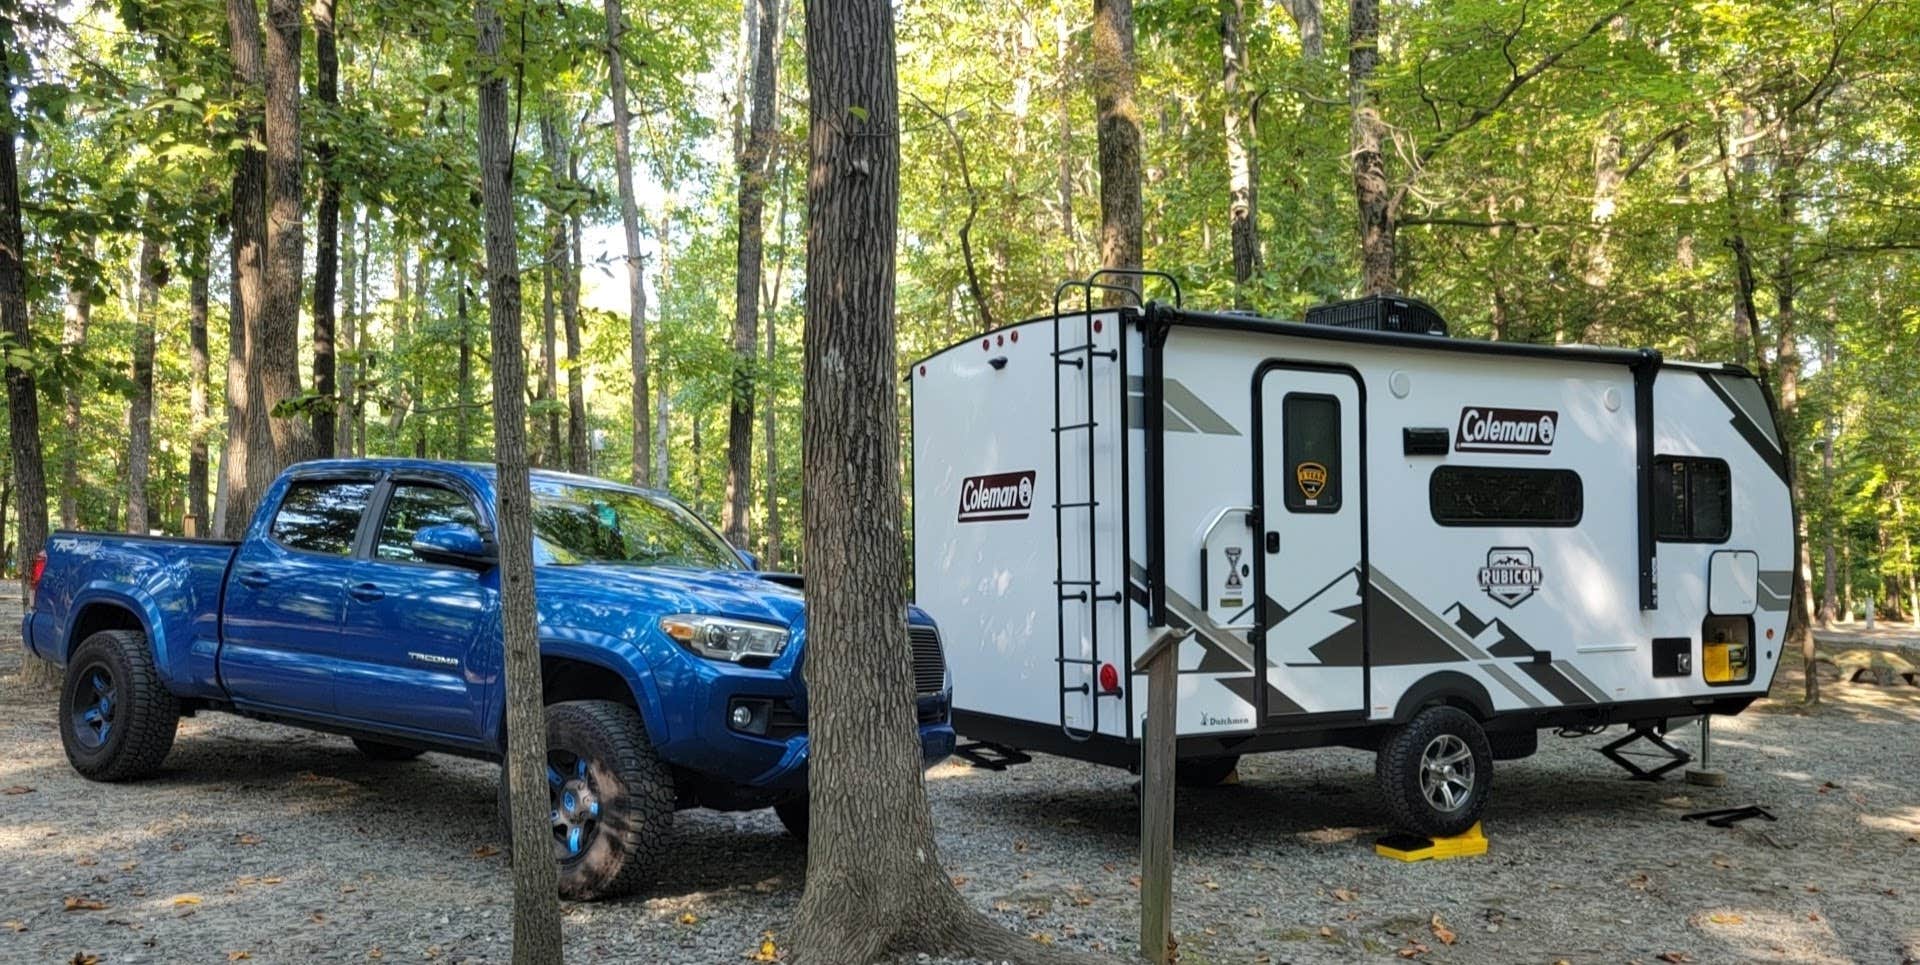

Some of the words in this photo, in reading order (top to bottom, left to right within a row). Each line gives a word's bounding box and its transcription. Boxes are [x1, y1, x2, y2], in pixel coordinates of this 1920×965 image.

[1462, 409, 1538, 442] Coleman
[963, 479, 1018, 512] Coleman
[1481, 569, 1540, 585] RUBICON
[408, 651, 459, 665] TACOMA
[1210, 717, 1249, 726] Dutchmen
